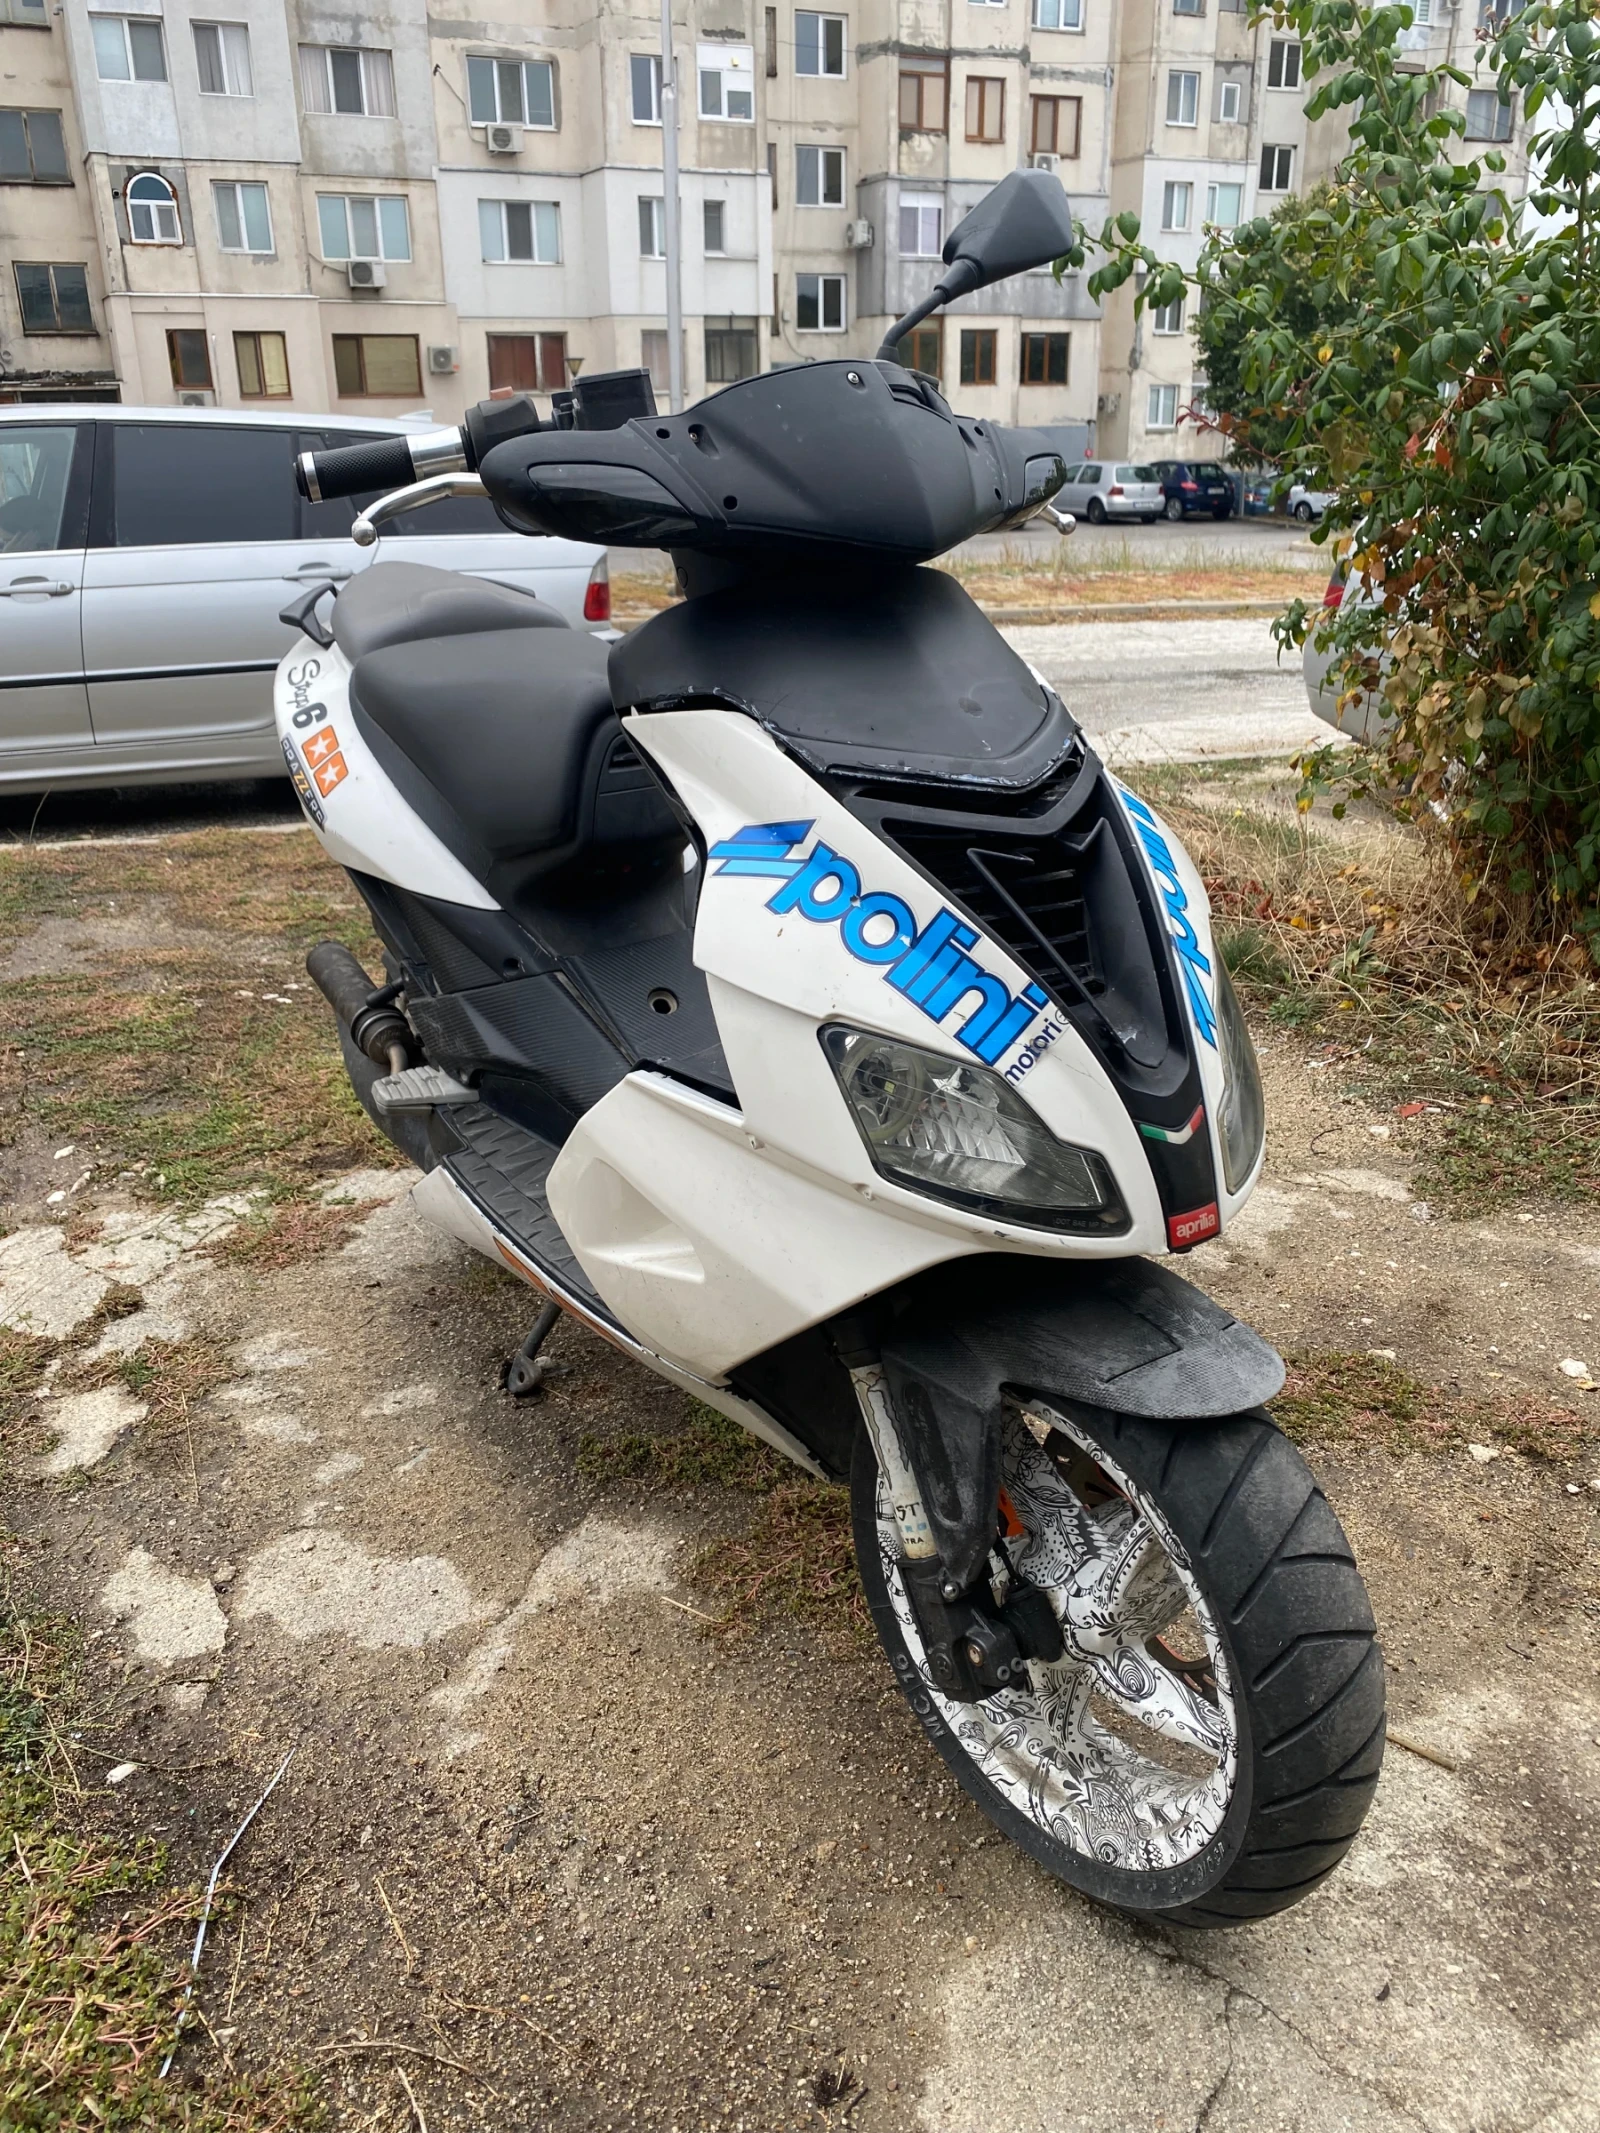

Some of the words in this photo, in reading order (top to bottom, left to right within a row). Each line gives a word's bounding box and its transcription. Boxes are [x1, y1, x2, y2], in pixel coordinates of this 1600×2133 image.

[762, 838, 1050, 1066] polini
[1004, 1017, 1063, 1087] motori
[1175, 1212, 1217, 1239] aprilia
[913, 1693, 948, 1738] MC
